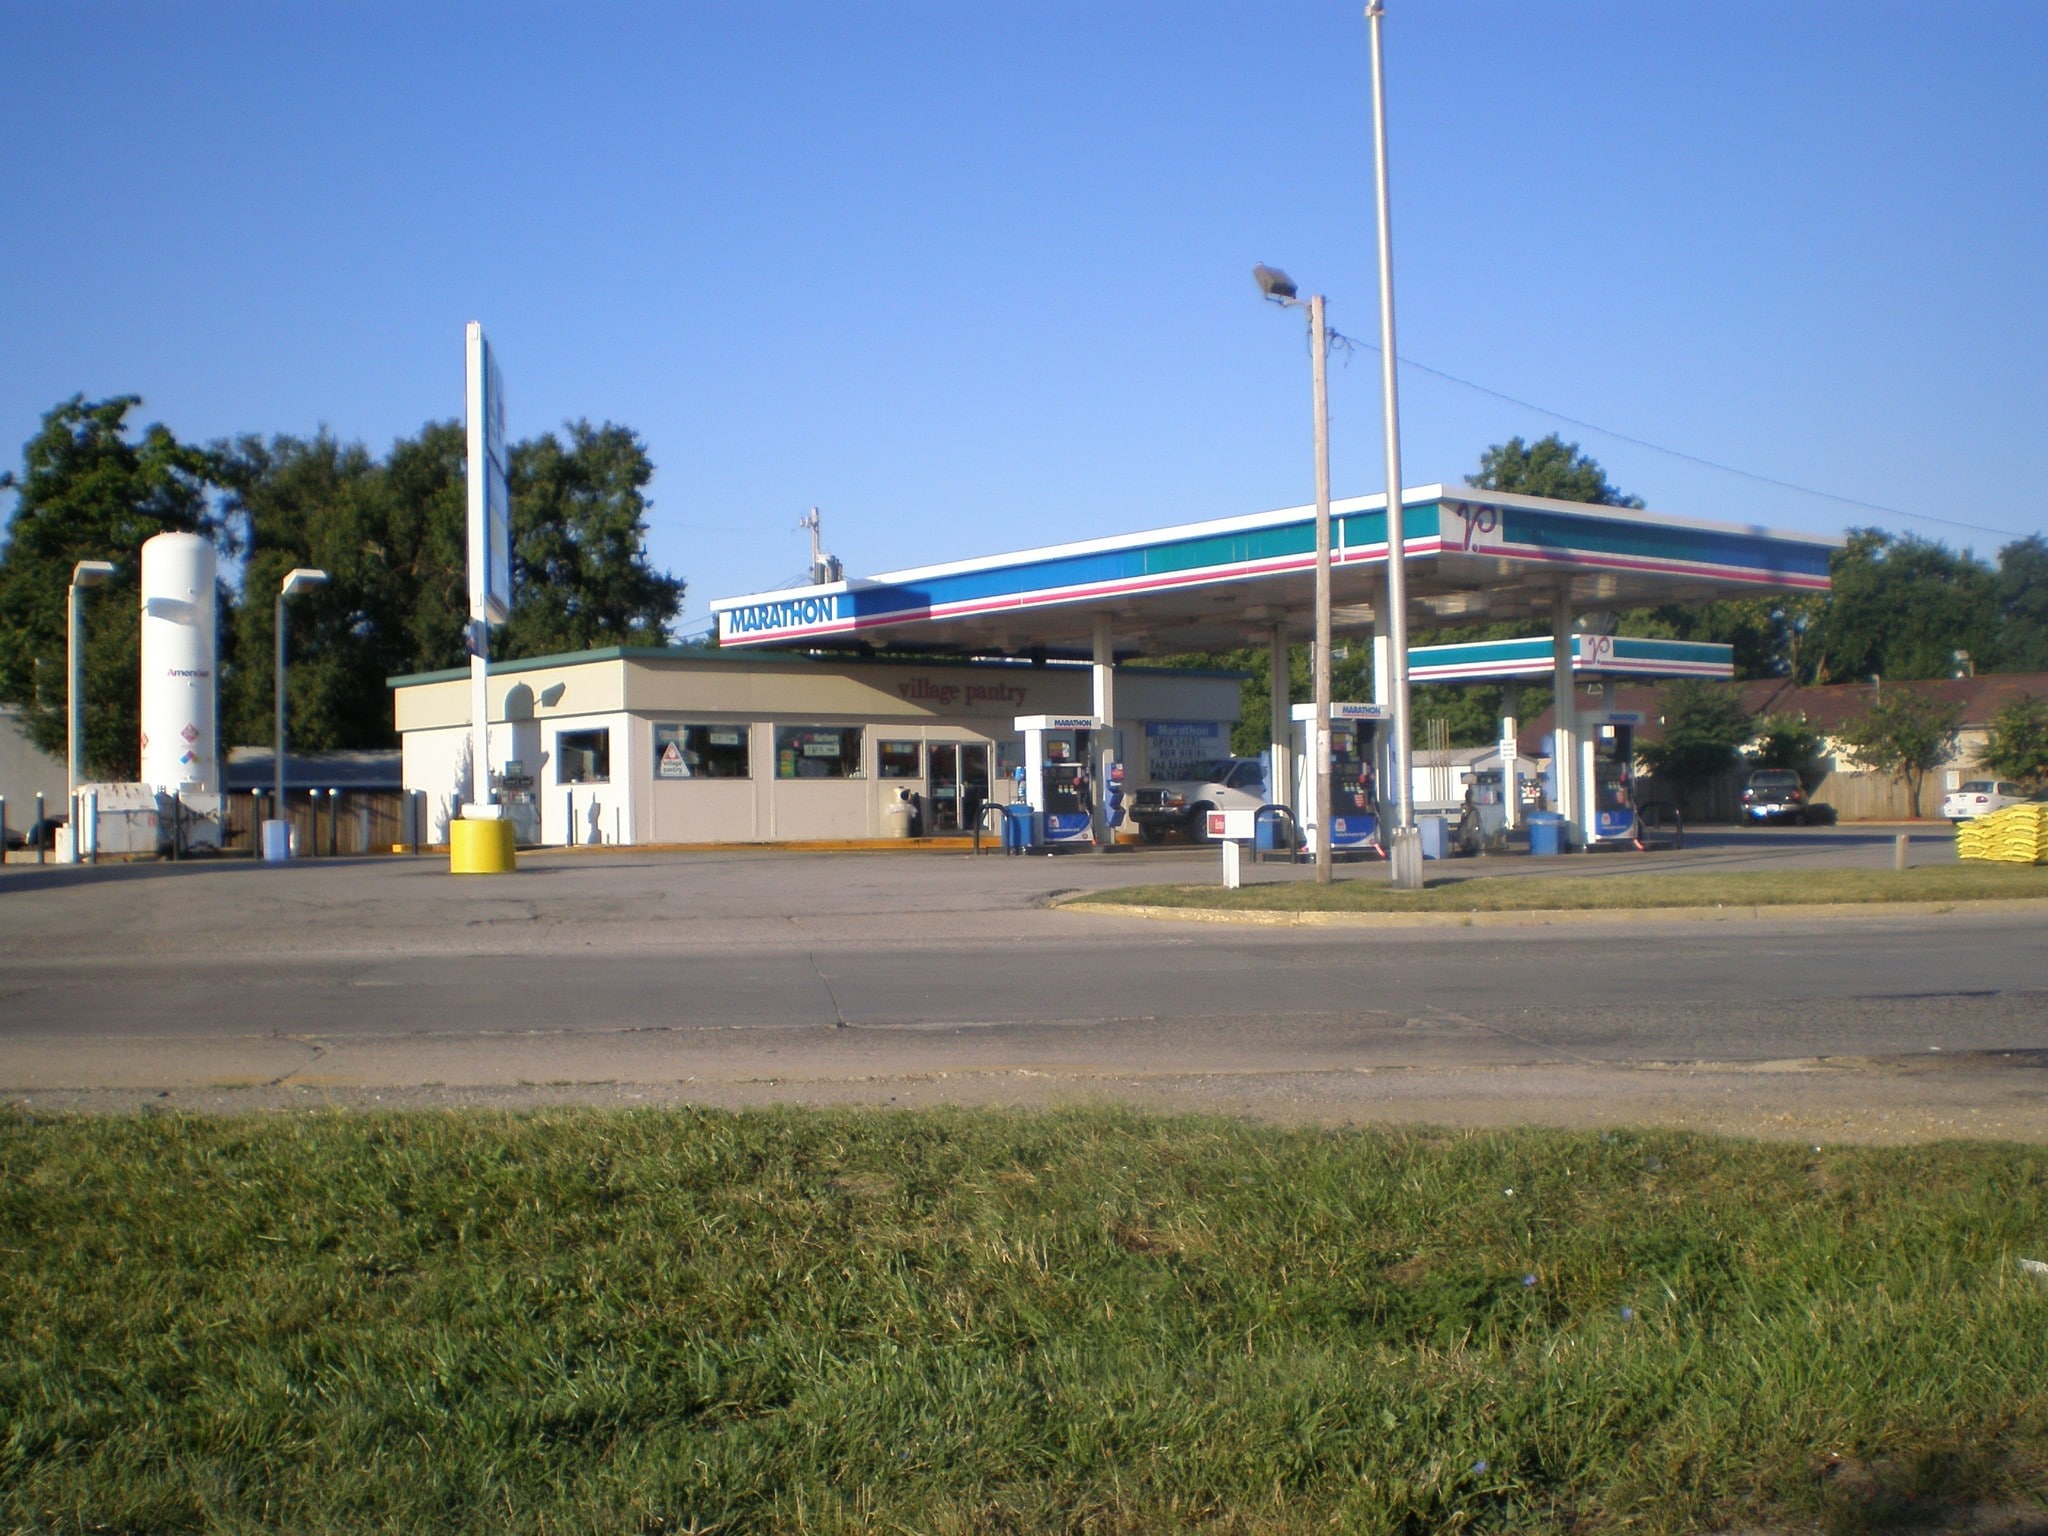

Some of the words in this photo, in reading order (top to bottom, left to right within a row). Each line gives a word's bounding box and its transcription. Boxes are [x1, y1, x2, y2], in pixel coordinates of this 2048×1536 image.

[729, 597, 833, 634] MARATHON
[899, 678, 960, 705] village
[965, 681, 1027, 707] pantry
[1341, 705, 1381, 714] MARATHON
[1054, 719, 1092, 727] MARATHON
[1158, 724, 1209, 737] Marathon
